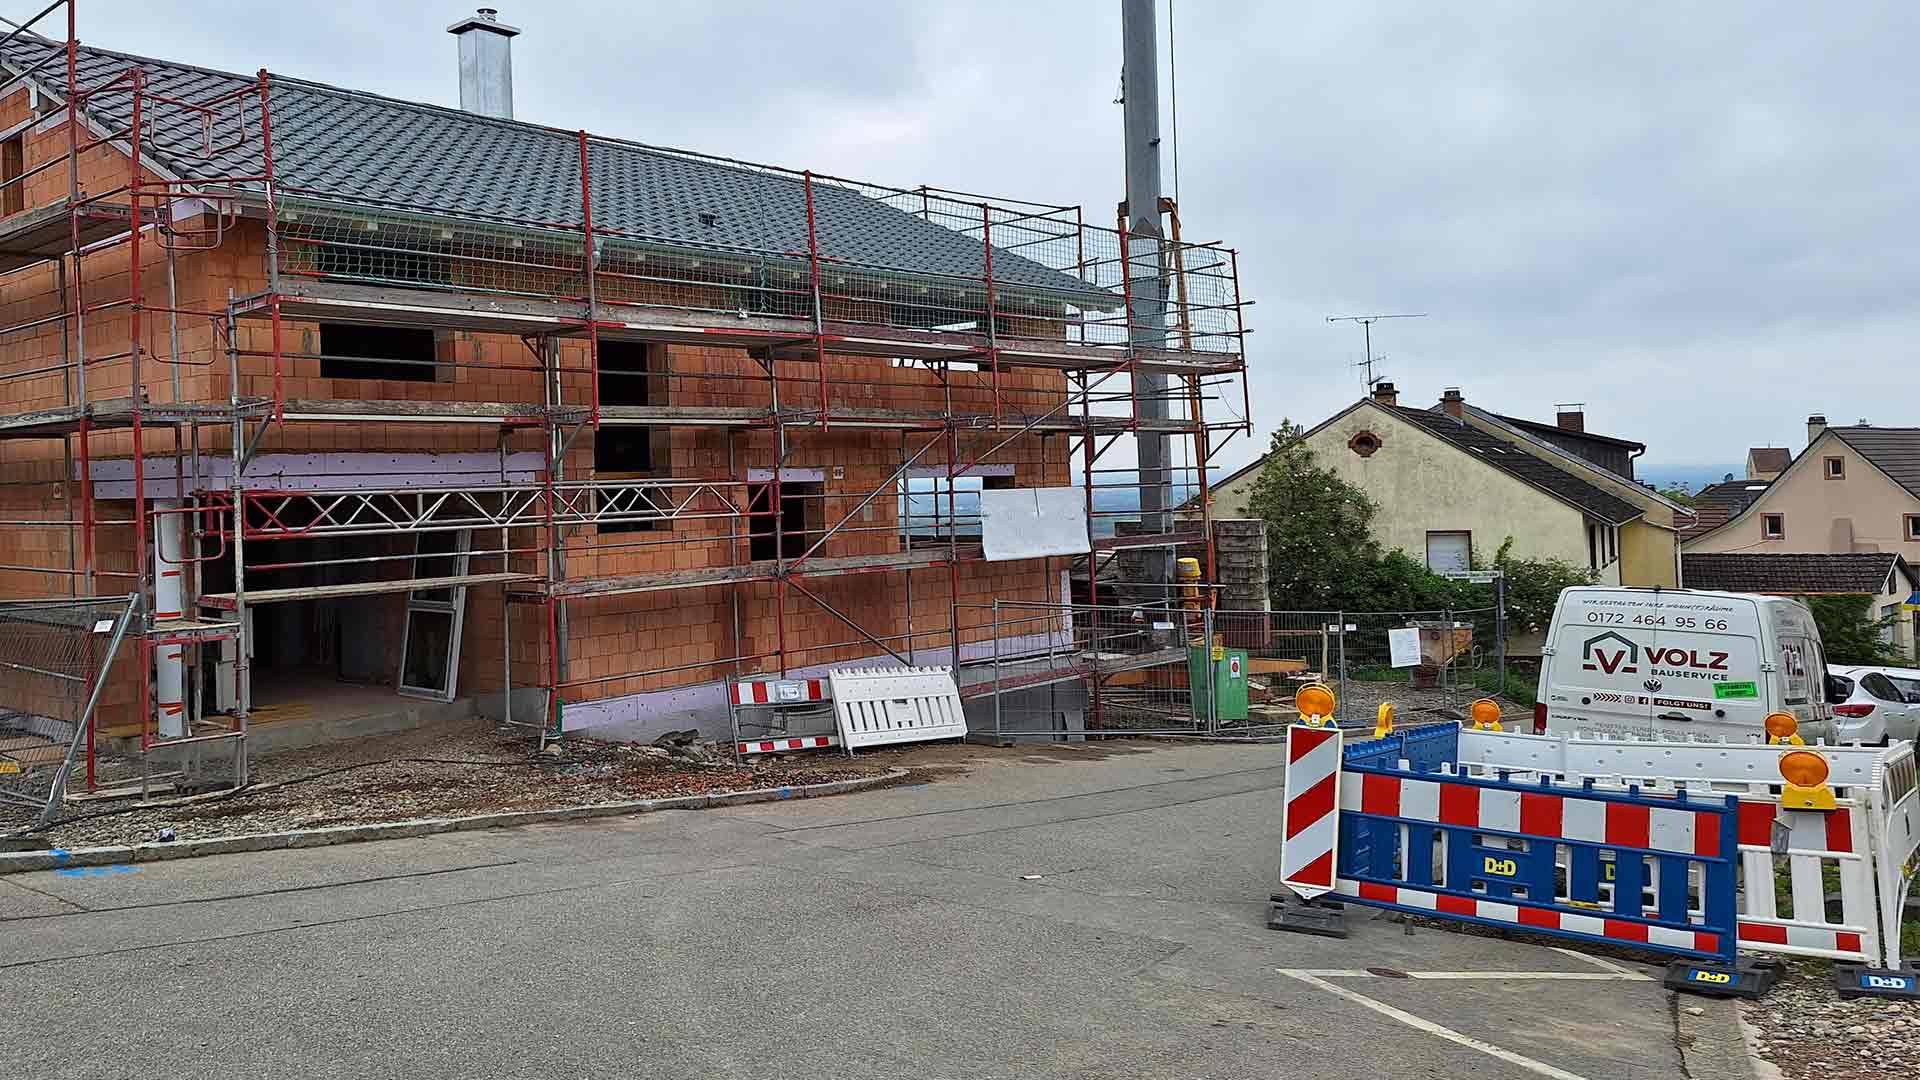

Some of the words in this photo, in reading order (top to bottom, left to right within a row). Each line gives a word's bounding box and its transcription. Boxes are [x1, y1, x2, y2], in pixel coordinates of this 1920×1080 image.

[1587, 612, 1625, 624] 0172
[1632, 615, 1666, 626] 464
[1675, 617, 1696, 628] 95
[1704, 619, 1728, 631] 66
[1644, 646, 1729, 670] VOLZ
[1650, 669, 1728, 682] BAUSERVICE
[1656, 699, 1685, 707] FOLGT
[1686, 702, 1709, 710] UNS!
[1484, 856, 1516, 876] D+D
[1695, 971, 1730, 984] D+D
[1868, 975, 1906, 989] D+D
